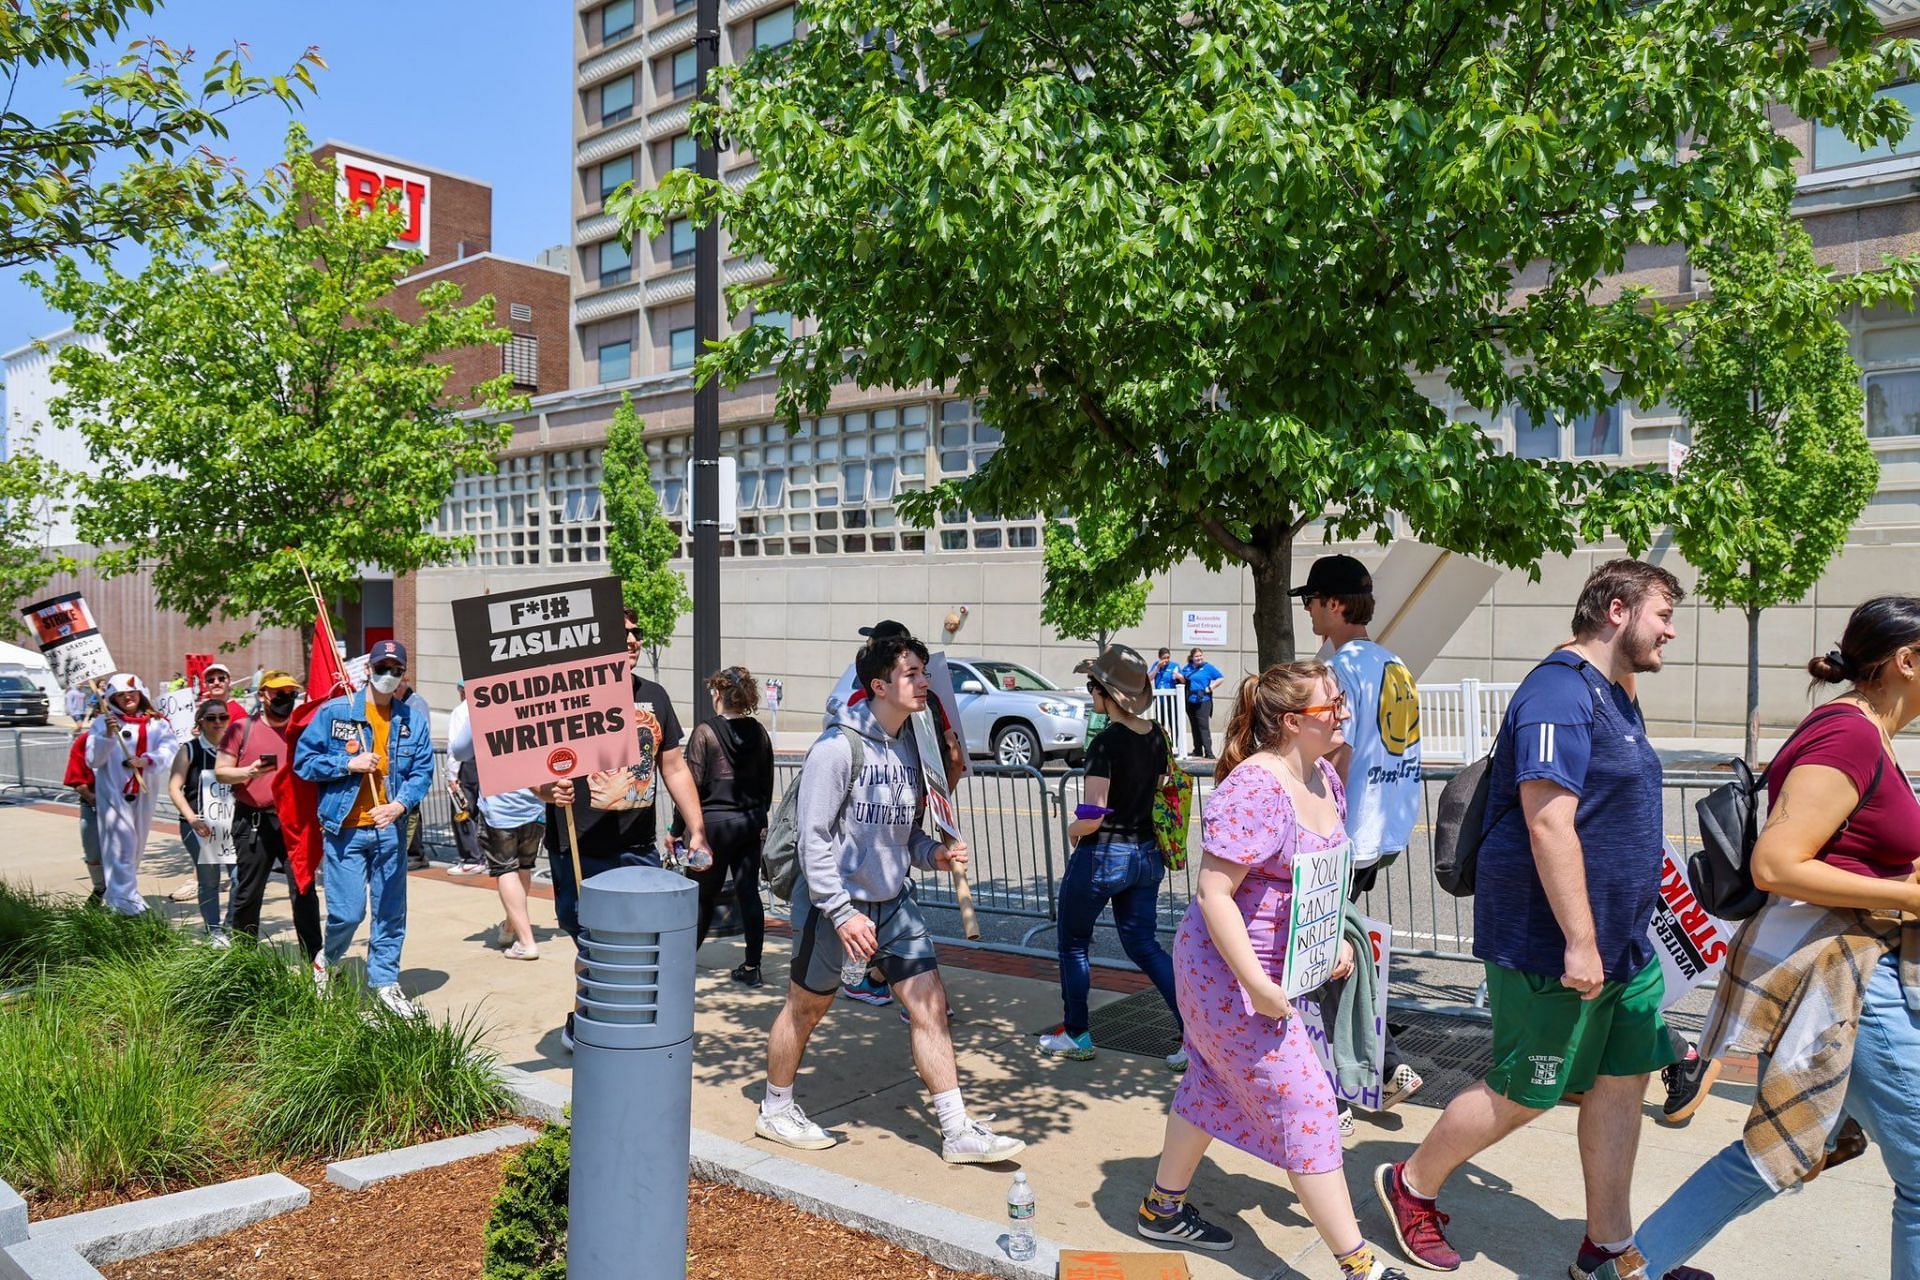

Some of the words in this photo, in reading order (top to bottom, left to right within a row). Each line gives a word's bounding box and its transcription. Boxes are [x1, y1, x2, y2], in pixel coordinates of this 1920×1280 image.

[489, 622, 601, 662] ZASLAV!
[473, 661, 626, 708] SOLIDARITY
[515, 701, 557, 720] WITH
[560, 694, 591, 711] THE
[485, 707, 625, 758] WRITERS
[859, 764, 919, 787] VILLANOV
[856, 802, 916, 826] UNIVERSIT
[1311, 856, 1338, 888] YOU
[1296, 888, 1338, 926] CAN'T
[1662, 908, 1676, 926] ON
[1297, 915, 1337, 951] WRITE
[1651, 915, 1697, 981] WRITERS
[1309, 941, 1326, 965] US
